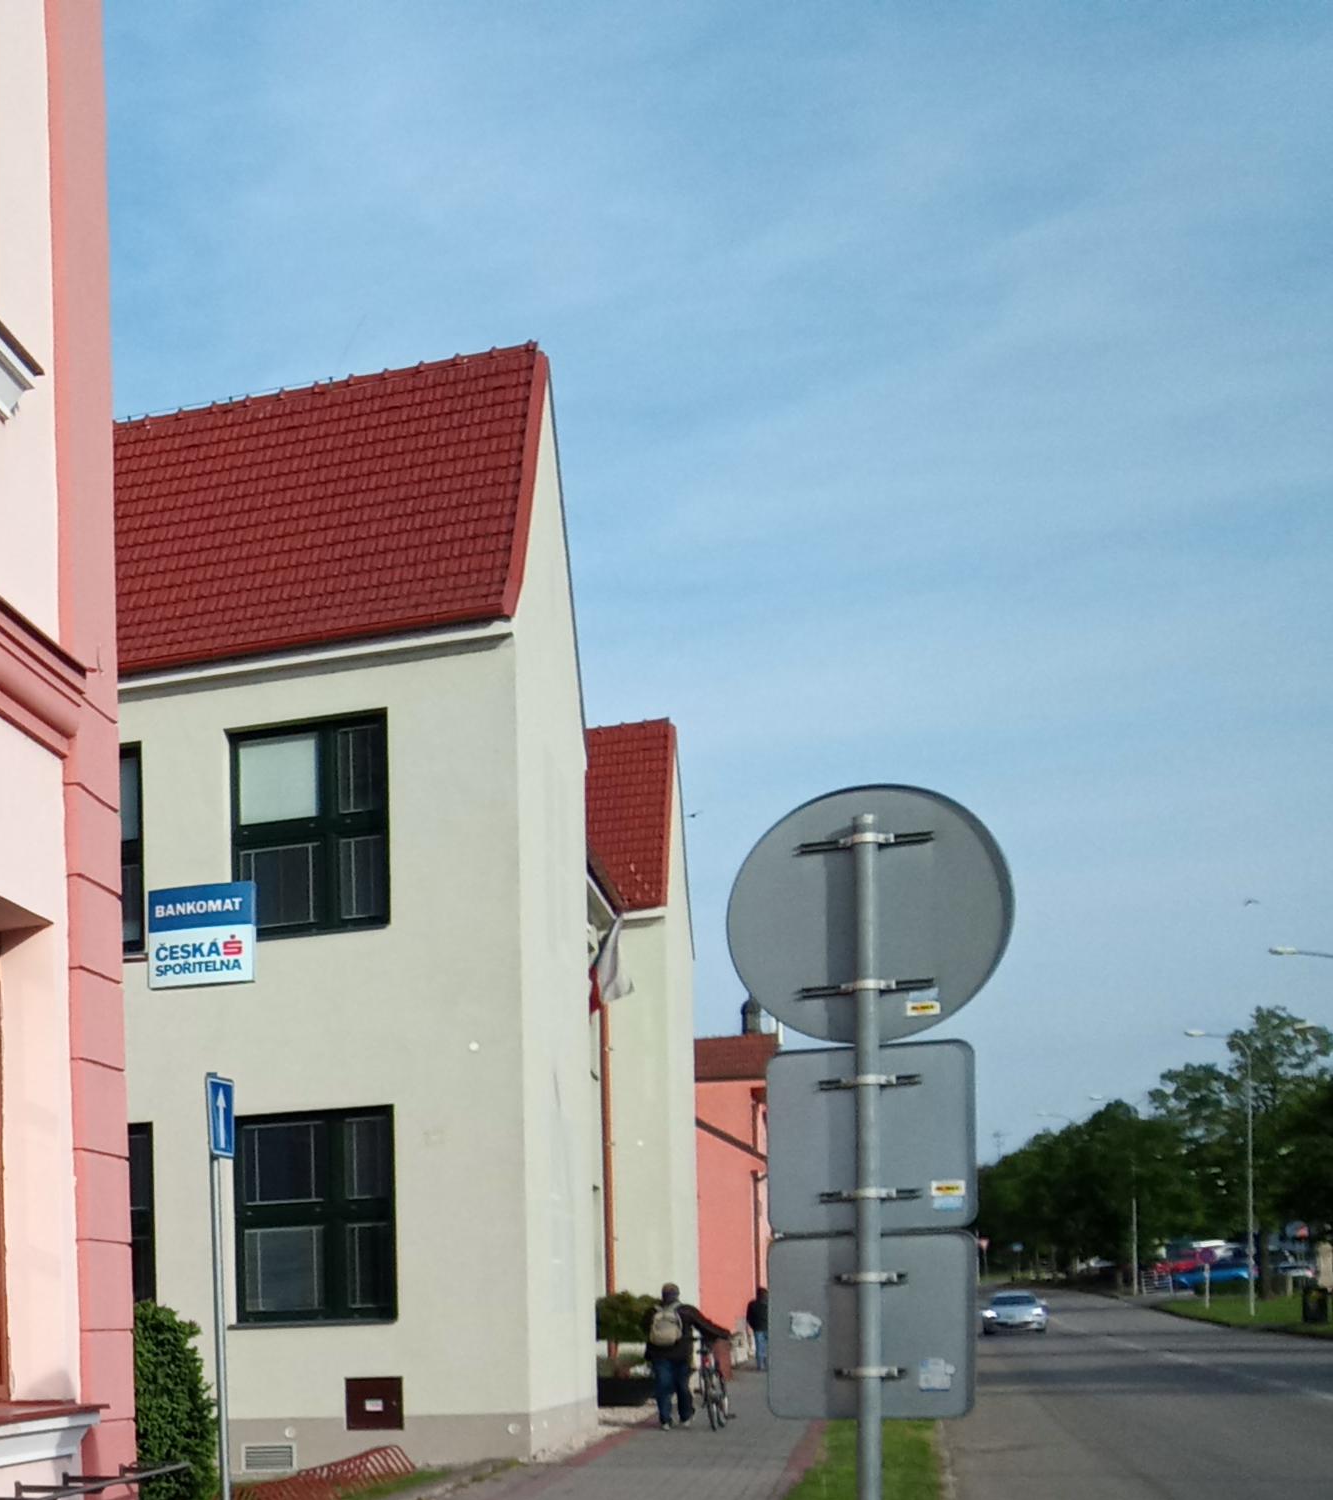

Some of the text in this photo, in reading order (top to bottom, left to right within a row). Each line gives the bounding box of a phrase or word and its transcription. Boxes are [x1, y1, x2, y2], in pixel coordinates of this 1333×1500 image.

[155, 897, 243, 919] BANKOMAT
[155, 938, 221, 962] ČESKÁ
[155, 959, 243, 977] SPOŘITELNA
